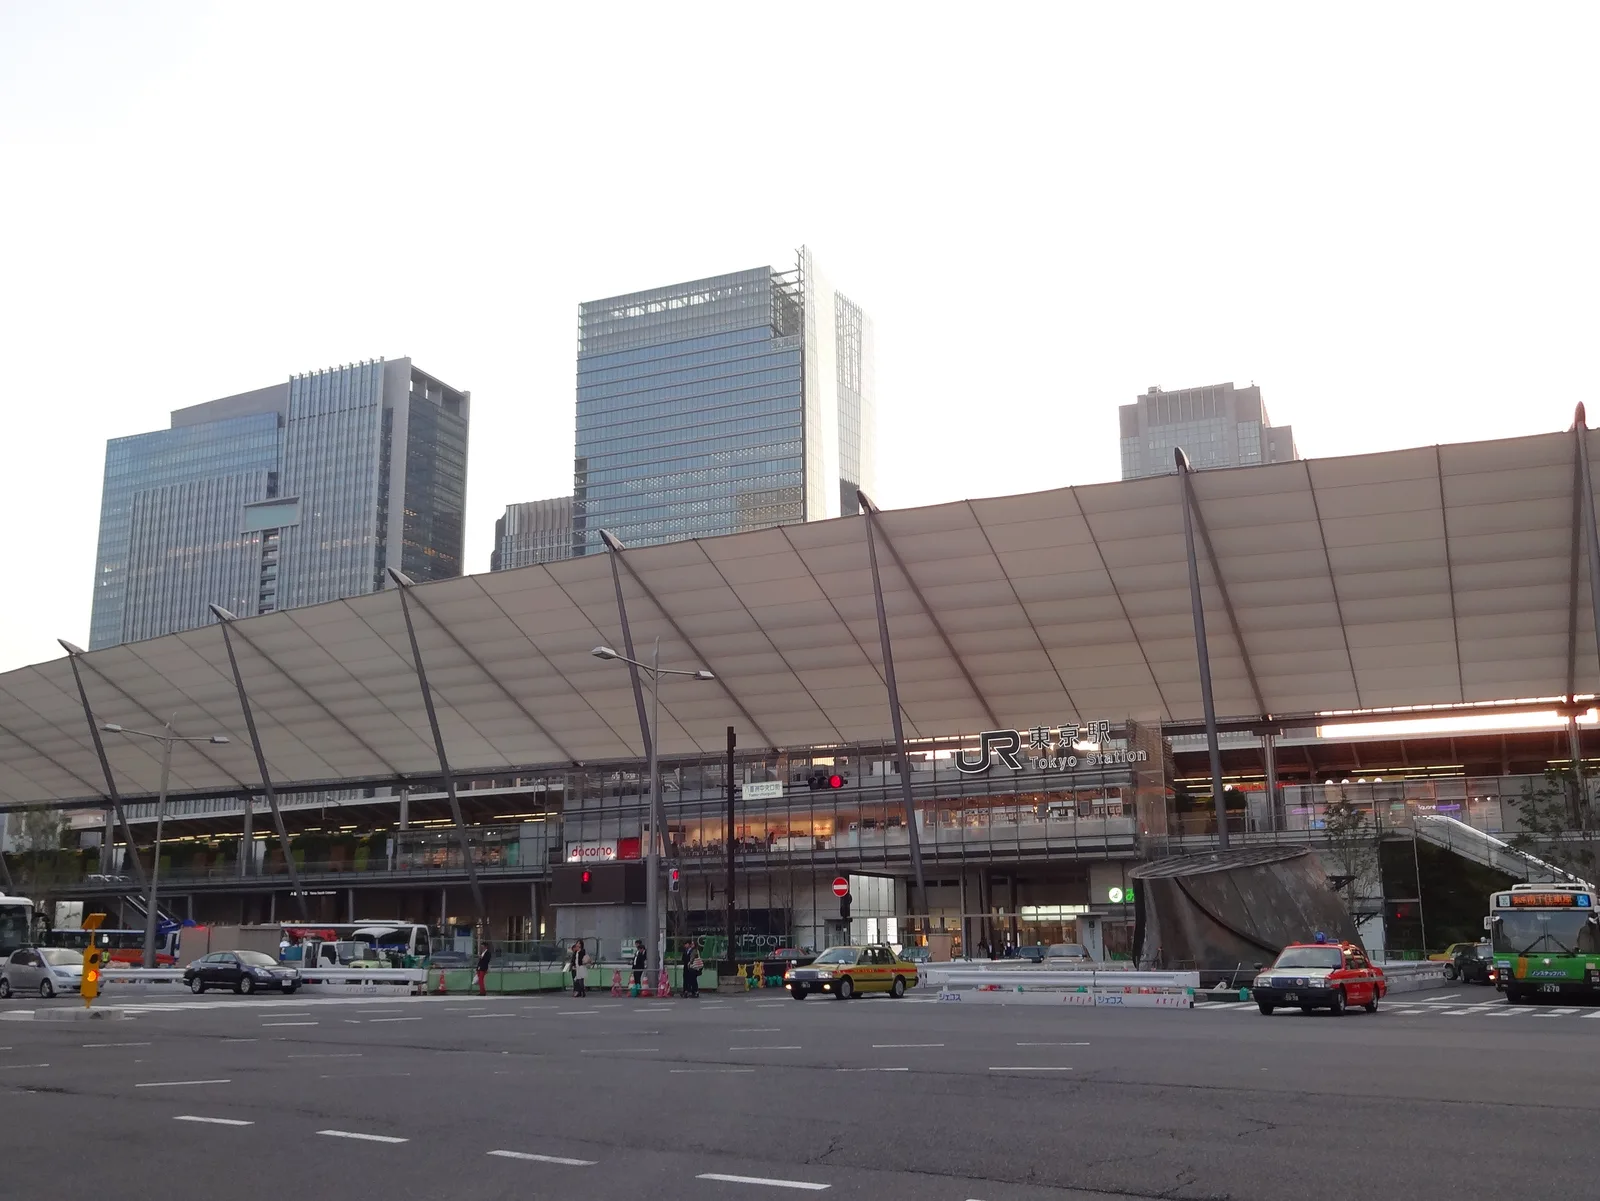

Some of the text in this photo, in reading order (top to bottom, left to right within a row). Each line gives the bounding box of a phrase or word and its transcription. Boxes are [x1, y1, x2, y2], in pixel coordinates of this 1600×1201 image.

[1028, 719, 1111, 750] 東京駅
[955, 729, 1022, 774] JR
[1029, 749, 1147, 772] Tokyo Station
[571, 845, 612, 857] docomo
